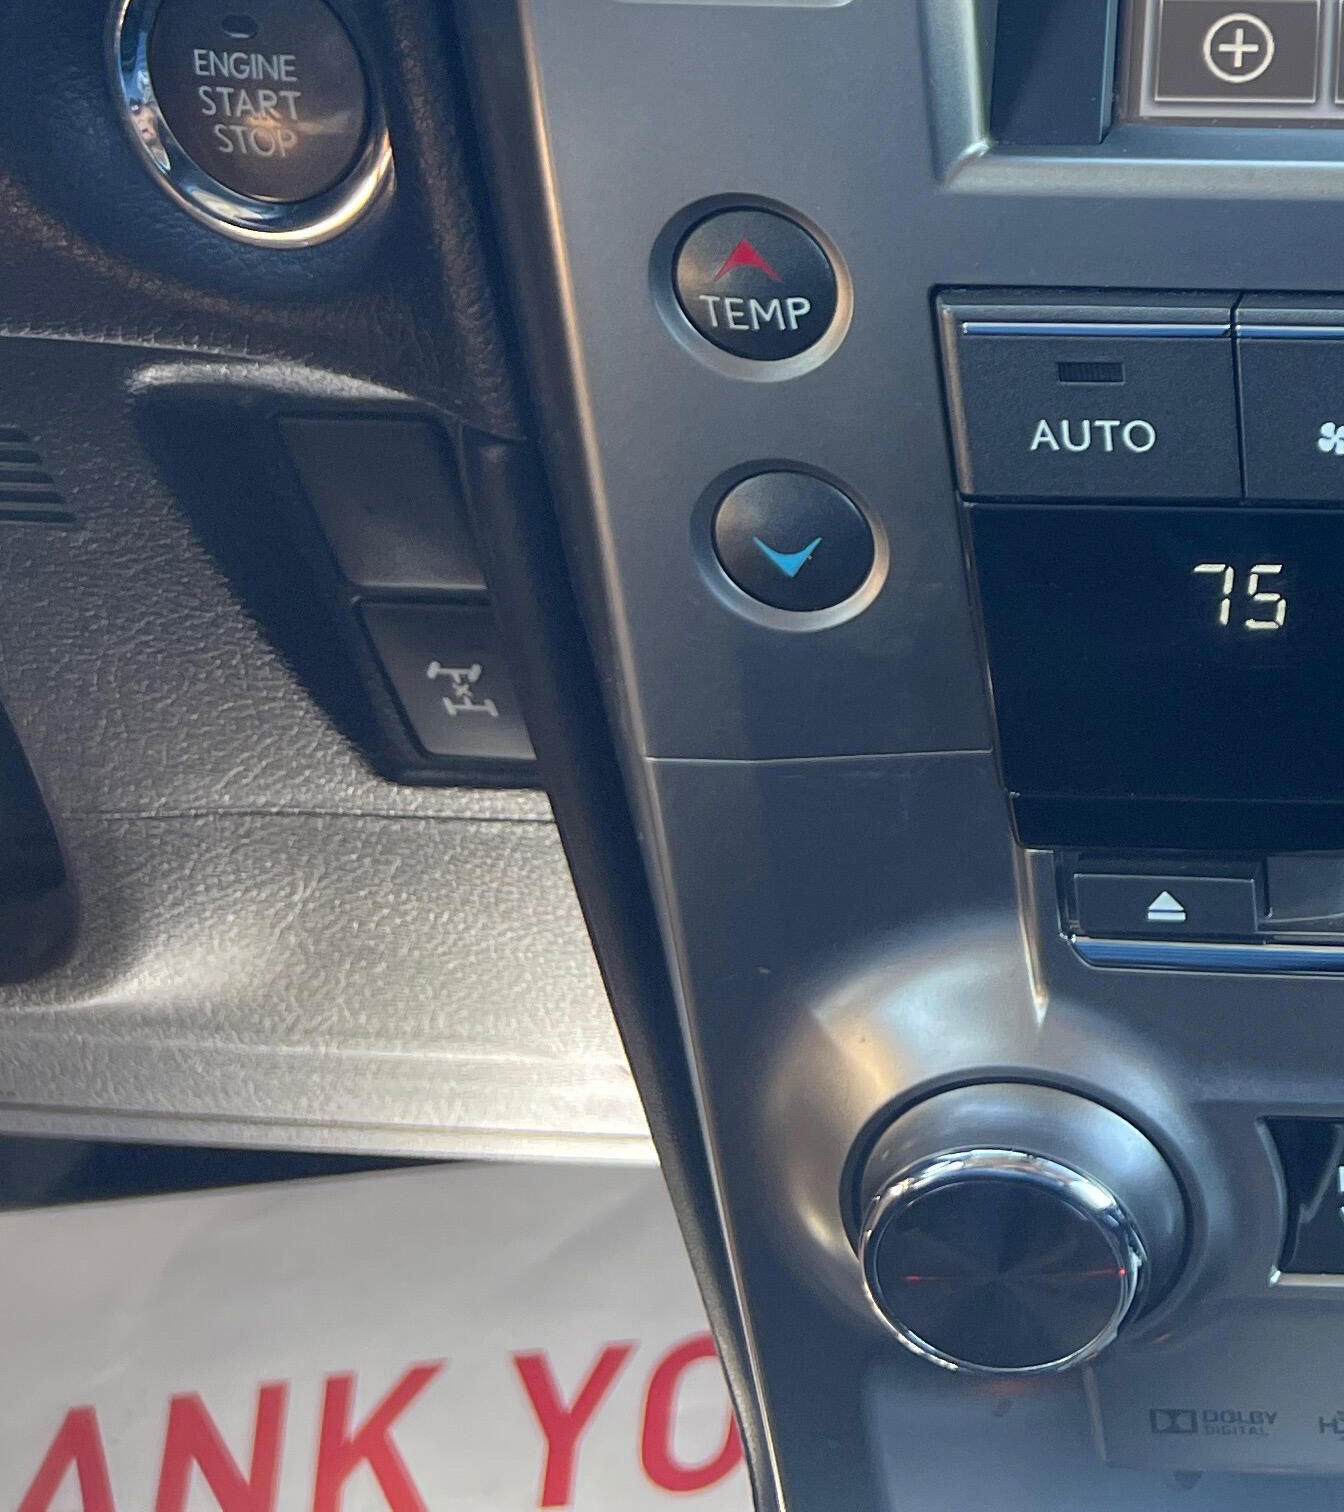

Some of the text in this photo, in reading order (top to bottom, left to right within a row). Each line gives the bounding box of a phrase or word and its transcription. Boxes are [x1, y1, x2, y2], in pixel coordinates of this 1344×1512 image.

[193, 48, 298, 82] ENGINE
[200, 86, 301, 121] START
[213, 124, 299, 159] STOP
[699, 293, 812, 333] TEMP
[1030, 419, 1156, 453] AUTO
[1193, 563, 1287, 630] 75
[1202, 1410, 1278, 1425] DOLBY
